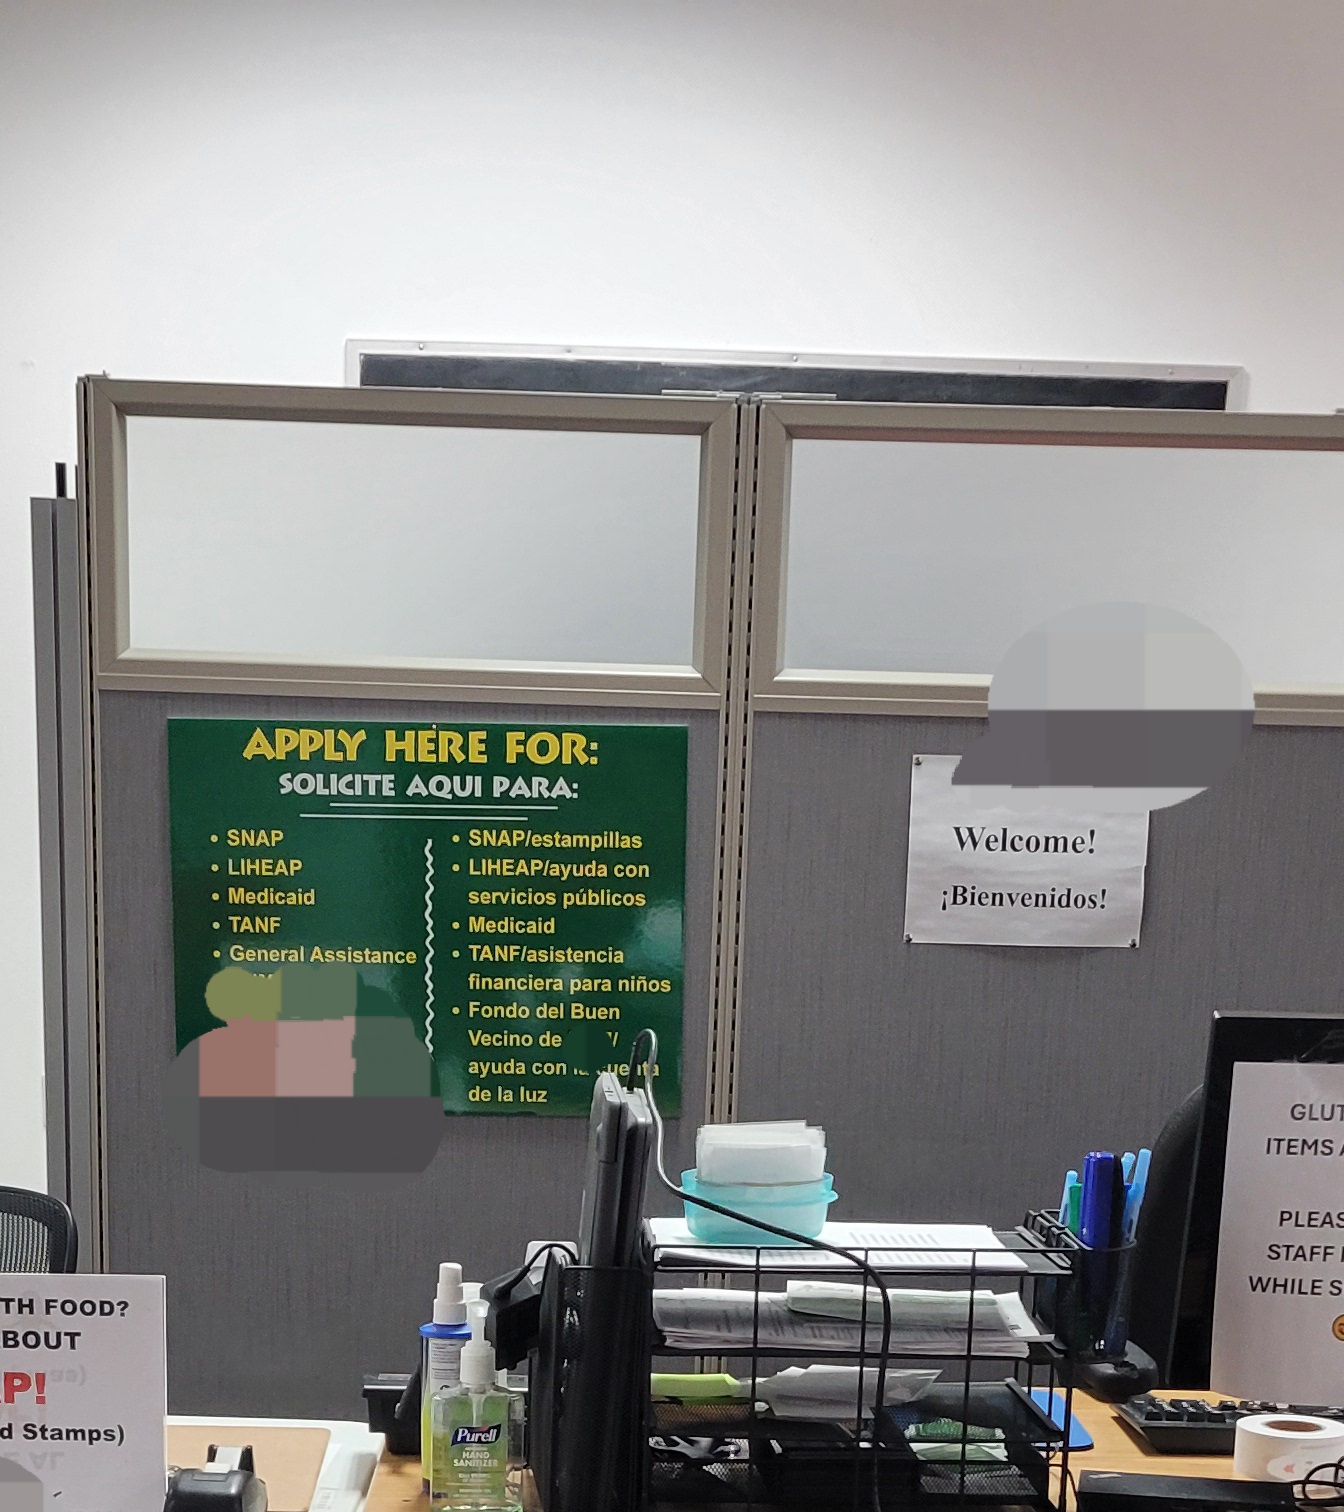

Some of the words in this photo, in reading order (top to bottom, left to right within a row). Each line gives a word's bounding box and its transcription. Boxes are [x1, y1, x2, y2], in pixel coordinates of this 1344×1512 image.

[242, 728, 366, 760] APPLY
[385, 730, 486, 763] HERE
[506, 732, 598, 765] FOR:
[279, 773, 395, 796] SOLICITE
[406, 774, 482, 800] AQUI
[493, 775, 578, 799] PARA:
[227, 830, 283, 846] SNAP
[468, 830, 643, 851] SNAP/estampillas
[953, 827, 1096, 854] Welcome!
[228, 860, 302, 876] LIHEAP
[468, 859, 608, 880] LIHEAP/ayuda
[614, 864, 649, 878] con
[228, 888, 315, 905] Medicaid
[468, 889, 556, 905] servicios
[563, 888, 646, 909] públicos
[941, 885, 1107, 911] ¡Bienvenidos!
[228, 917, 281, 933] TANF
[468, 917, 555, 934] Medicaid
[229, 946, 304, 962] General
[310, 948, 416, 963] Assistance
[468, 946, 624, 963] TANF/asistencia
[468, 975, 563, 991] financiera
[569, 979, 612, 995] para
[618, 976, 671, 992] niños
[468, 1003, 529, 1019] Fondo
[535, 1004, 565, 1019] del
[570, 1004, 620, 1020] Buen
[468, 1032, 533, 1047] Vecino
[539, 1032, 562, 1047] de
[468, 1058, 526, 1078] ayuda
[532, 1062, 566, 1075] con
[468, 1085, 491, 1102] de
[498, 1086, 513, 1102] la
[520, 1086, 547, 1102] luz
[1266, 1138, 1333, 1156] ITEMS
[1266, 1244, 1335, 1262] STAFF
[1248, 1276, 1323, 1295] WHILE
[44, 1298, 129, 1317] FOOD?
[23, 1422, 125, 1445] Stamps)
[453, 1459, 498, 1467] SANITIZER
